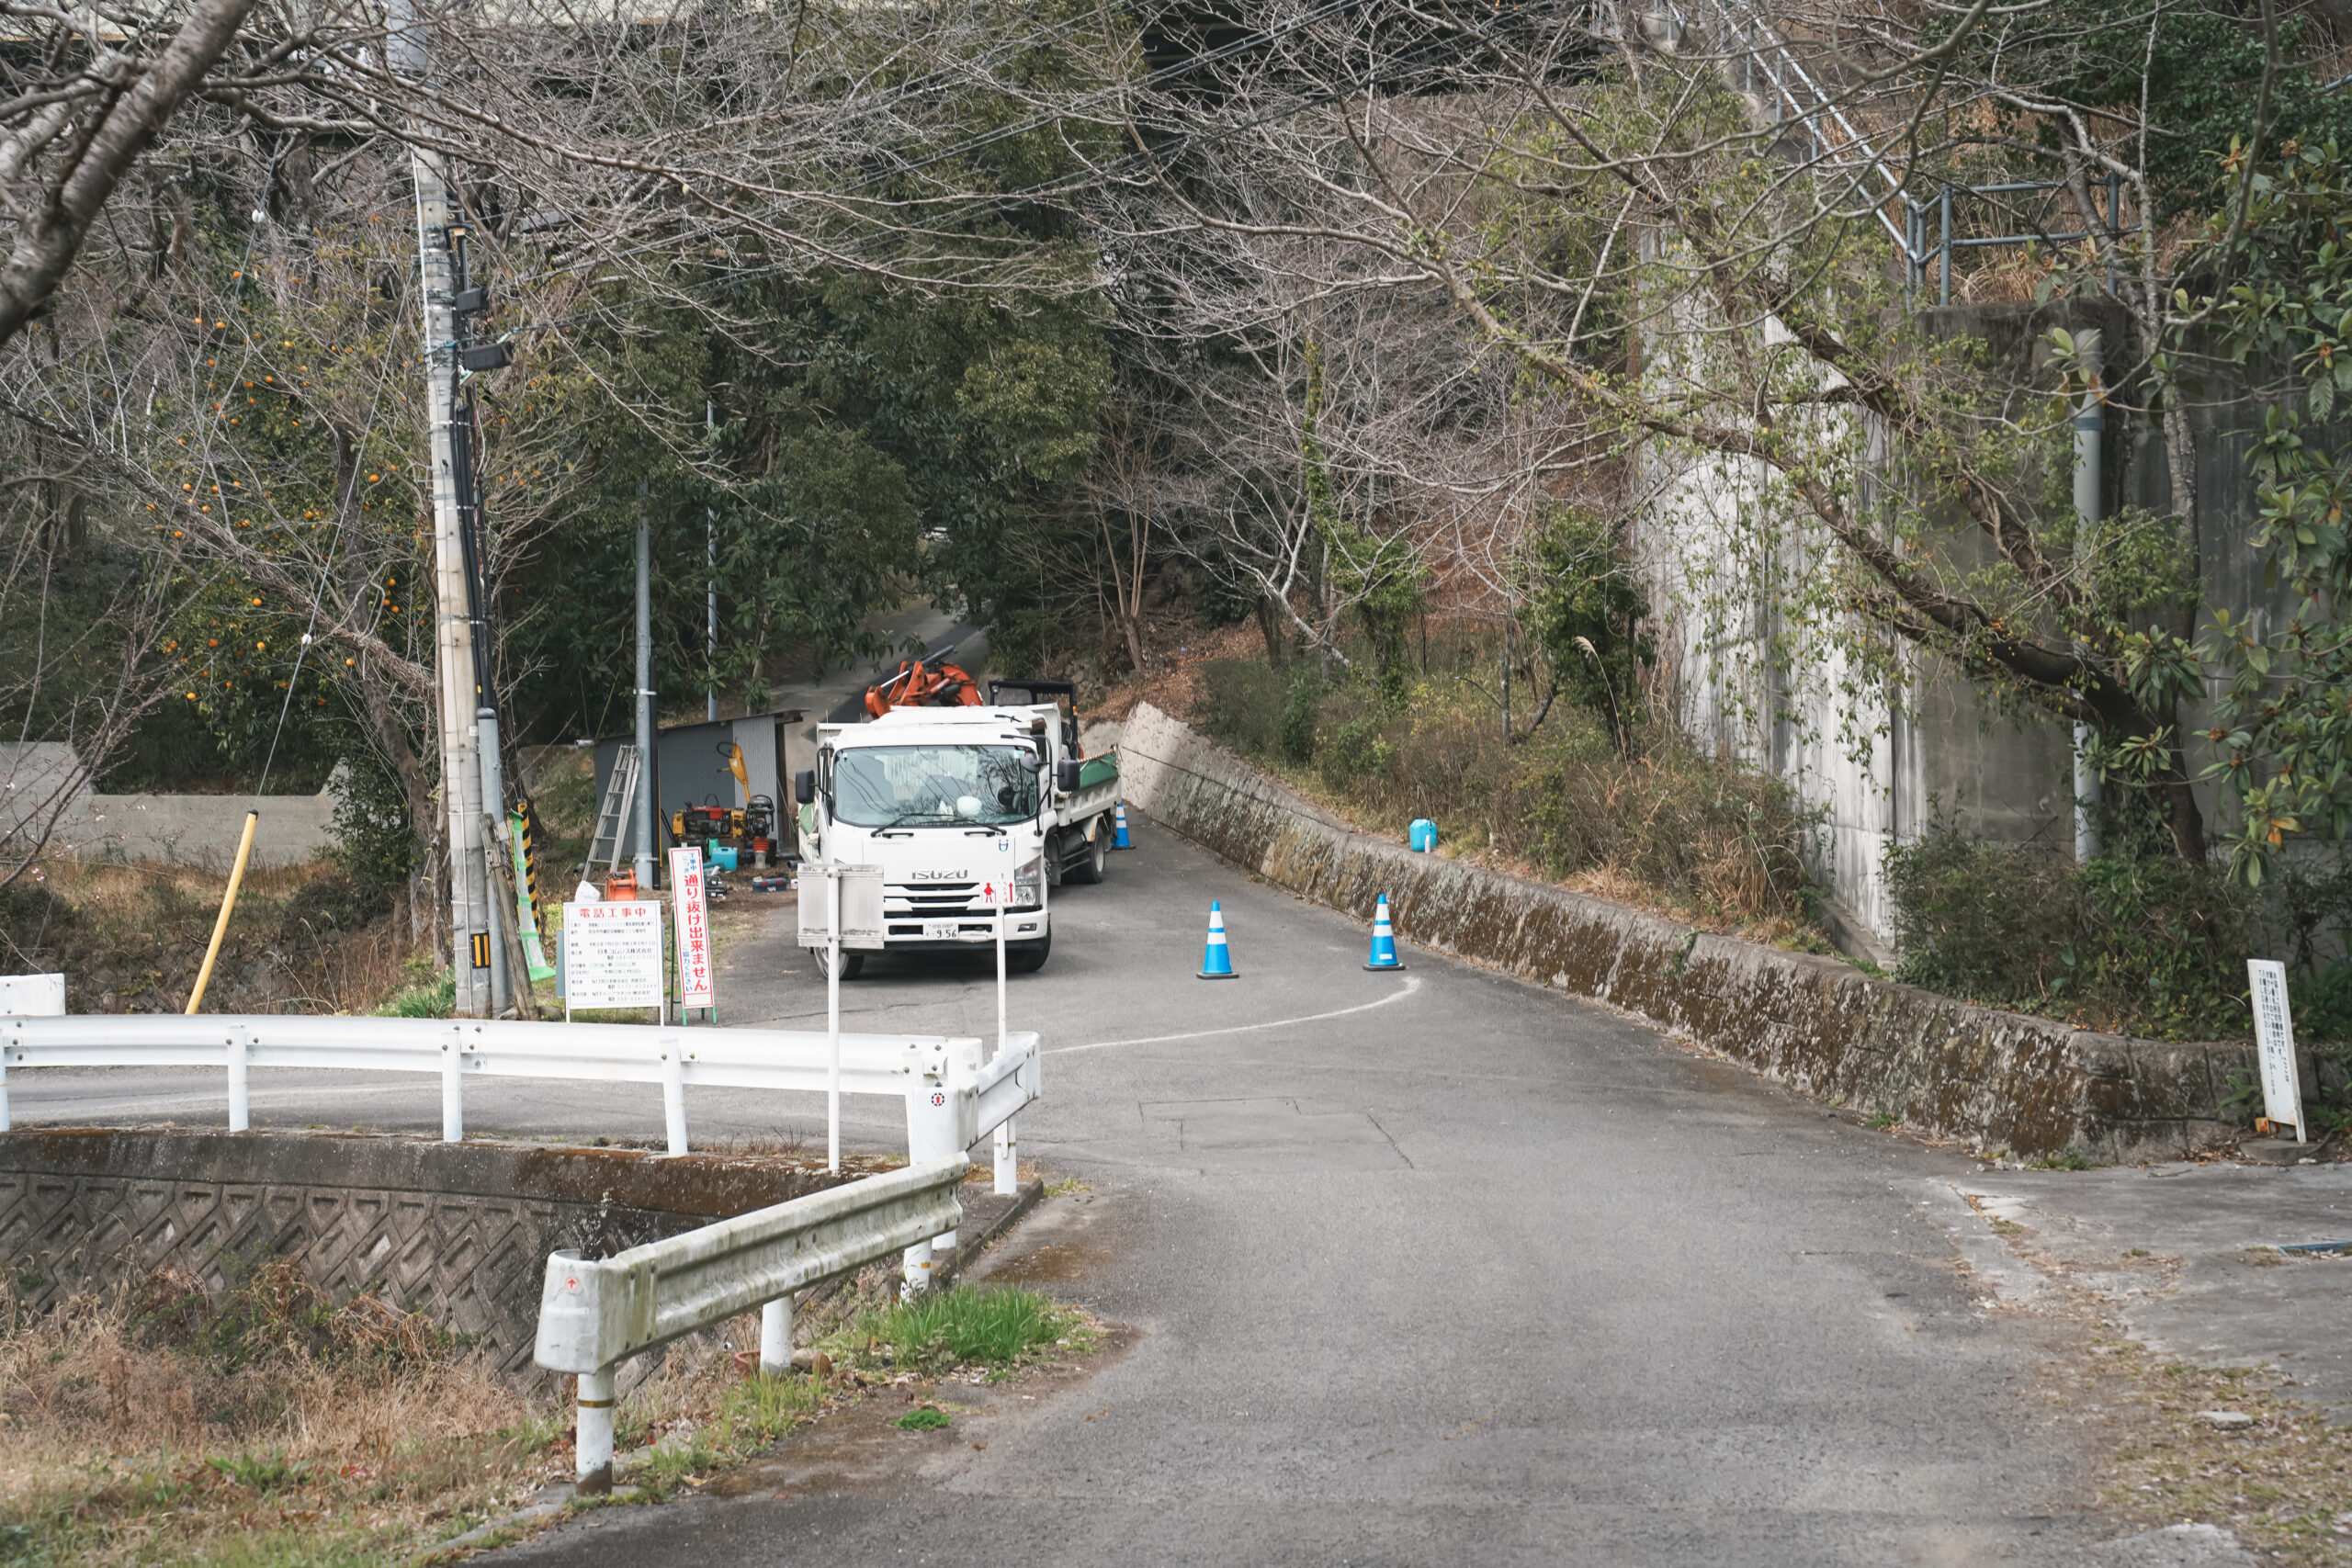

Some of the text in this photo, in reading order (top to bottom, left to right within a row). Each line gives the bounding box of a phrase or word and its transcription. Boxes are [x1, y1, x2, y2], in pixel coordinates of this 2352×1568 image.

[911, 869, 968, 880] ISUZU
[579, 907, 647, 919] 電話工事中
[684, 874, 707, 992] 通り抜け出来ません
